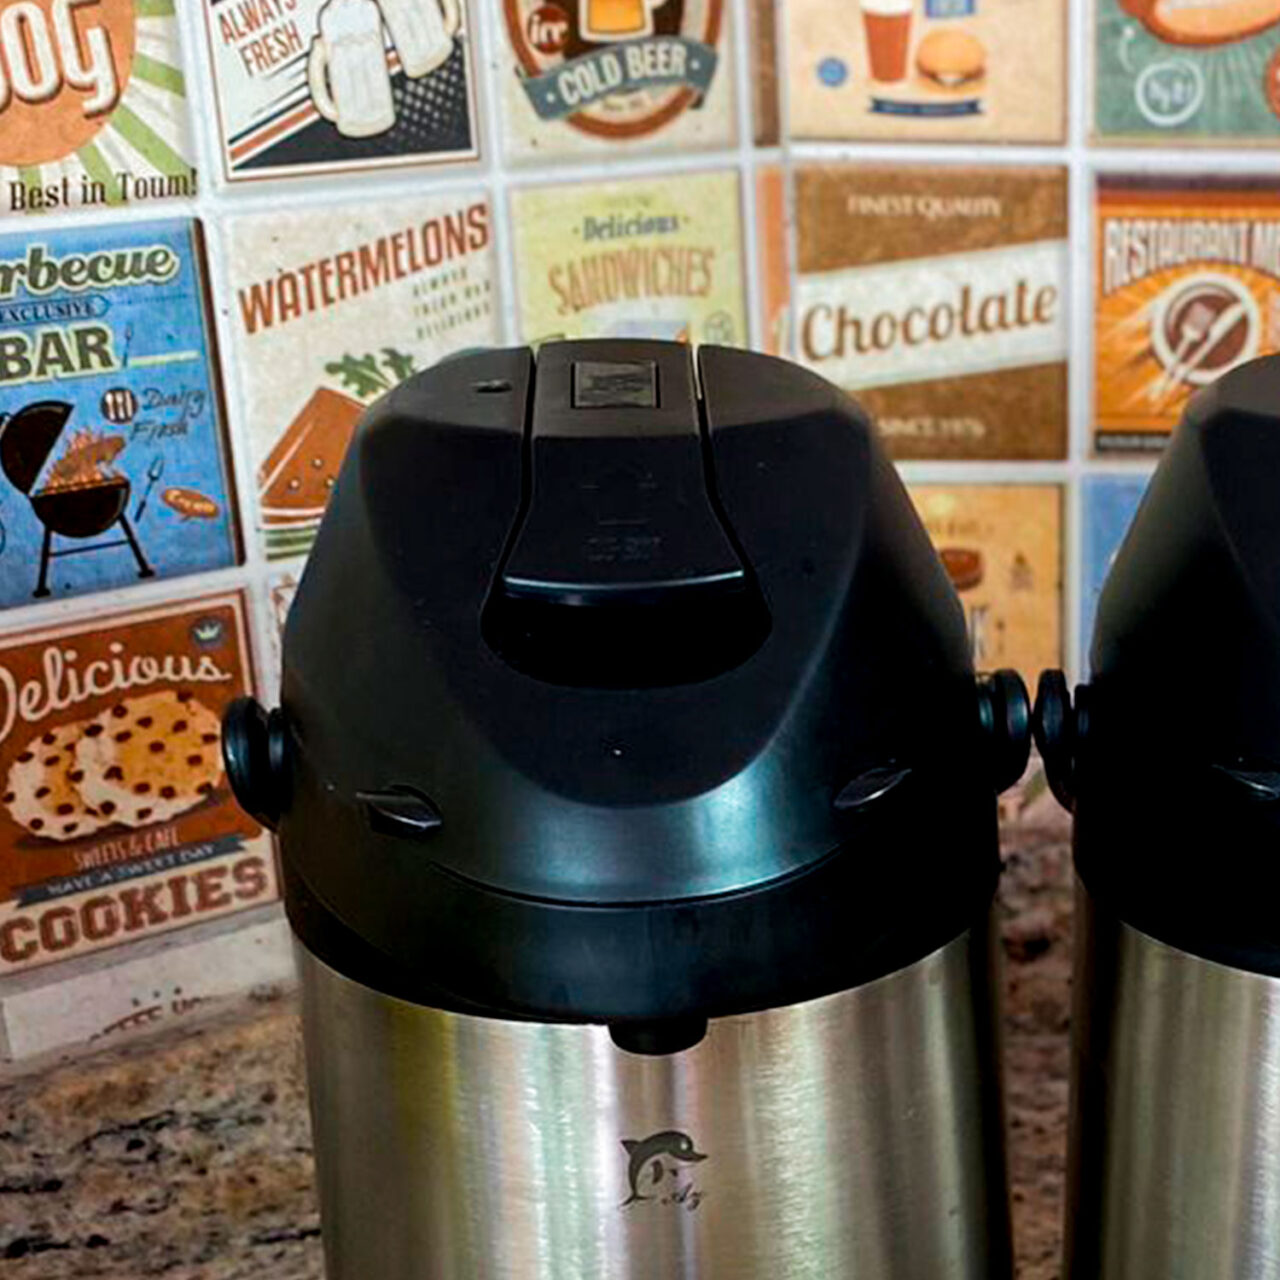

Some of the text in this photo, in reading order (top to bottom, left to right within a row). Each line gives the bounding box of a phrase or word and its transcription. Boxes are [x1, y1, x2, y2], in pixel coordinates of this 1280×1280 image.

[239, 19, 303, 78] FRESH
[557, 42, 688, 106] COLD BEER
[10, 177, 70, 212] Best
[82, 175, 107, 205] in
[237, 203, 490, 335] WATERMELONS
[801, 279, 1058, 362] Chocolate
[0, 325, 115, 381] BAR
[1, 857, 268, 963] COOKIES
[48, 875, 97, 896] HAVE
[100, 871, 113, 884] A
